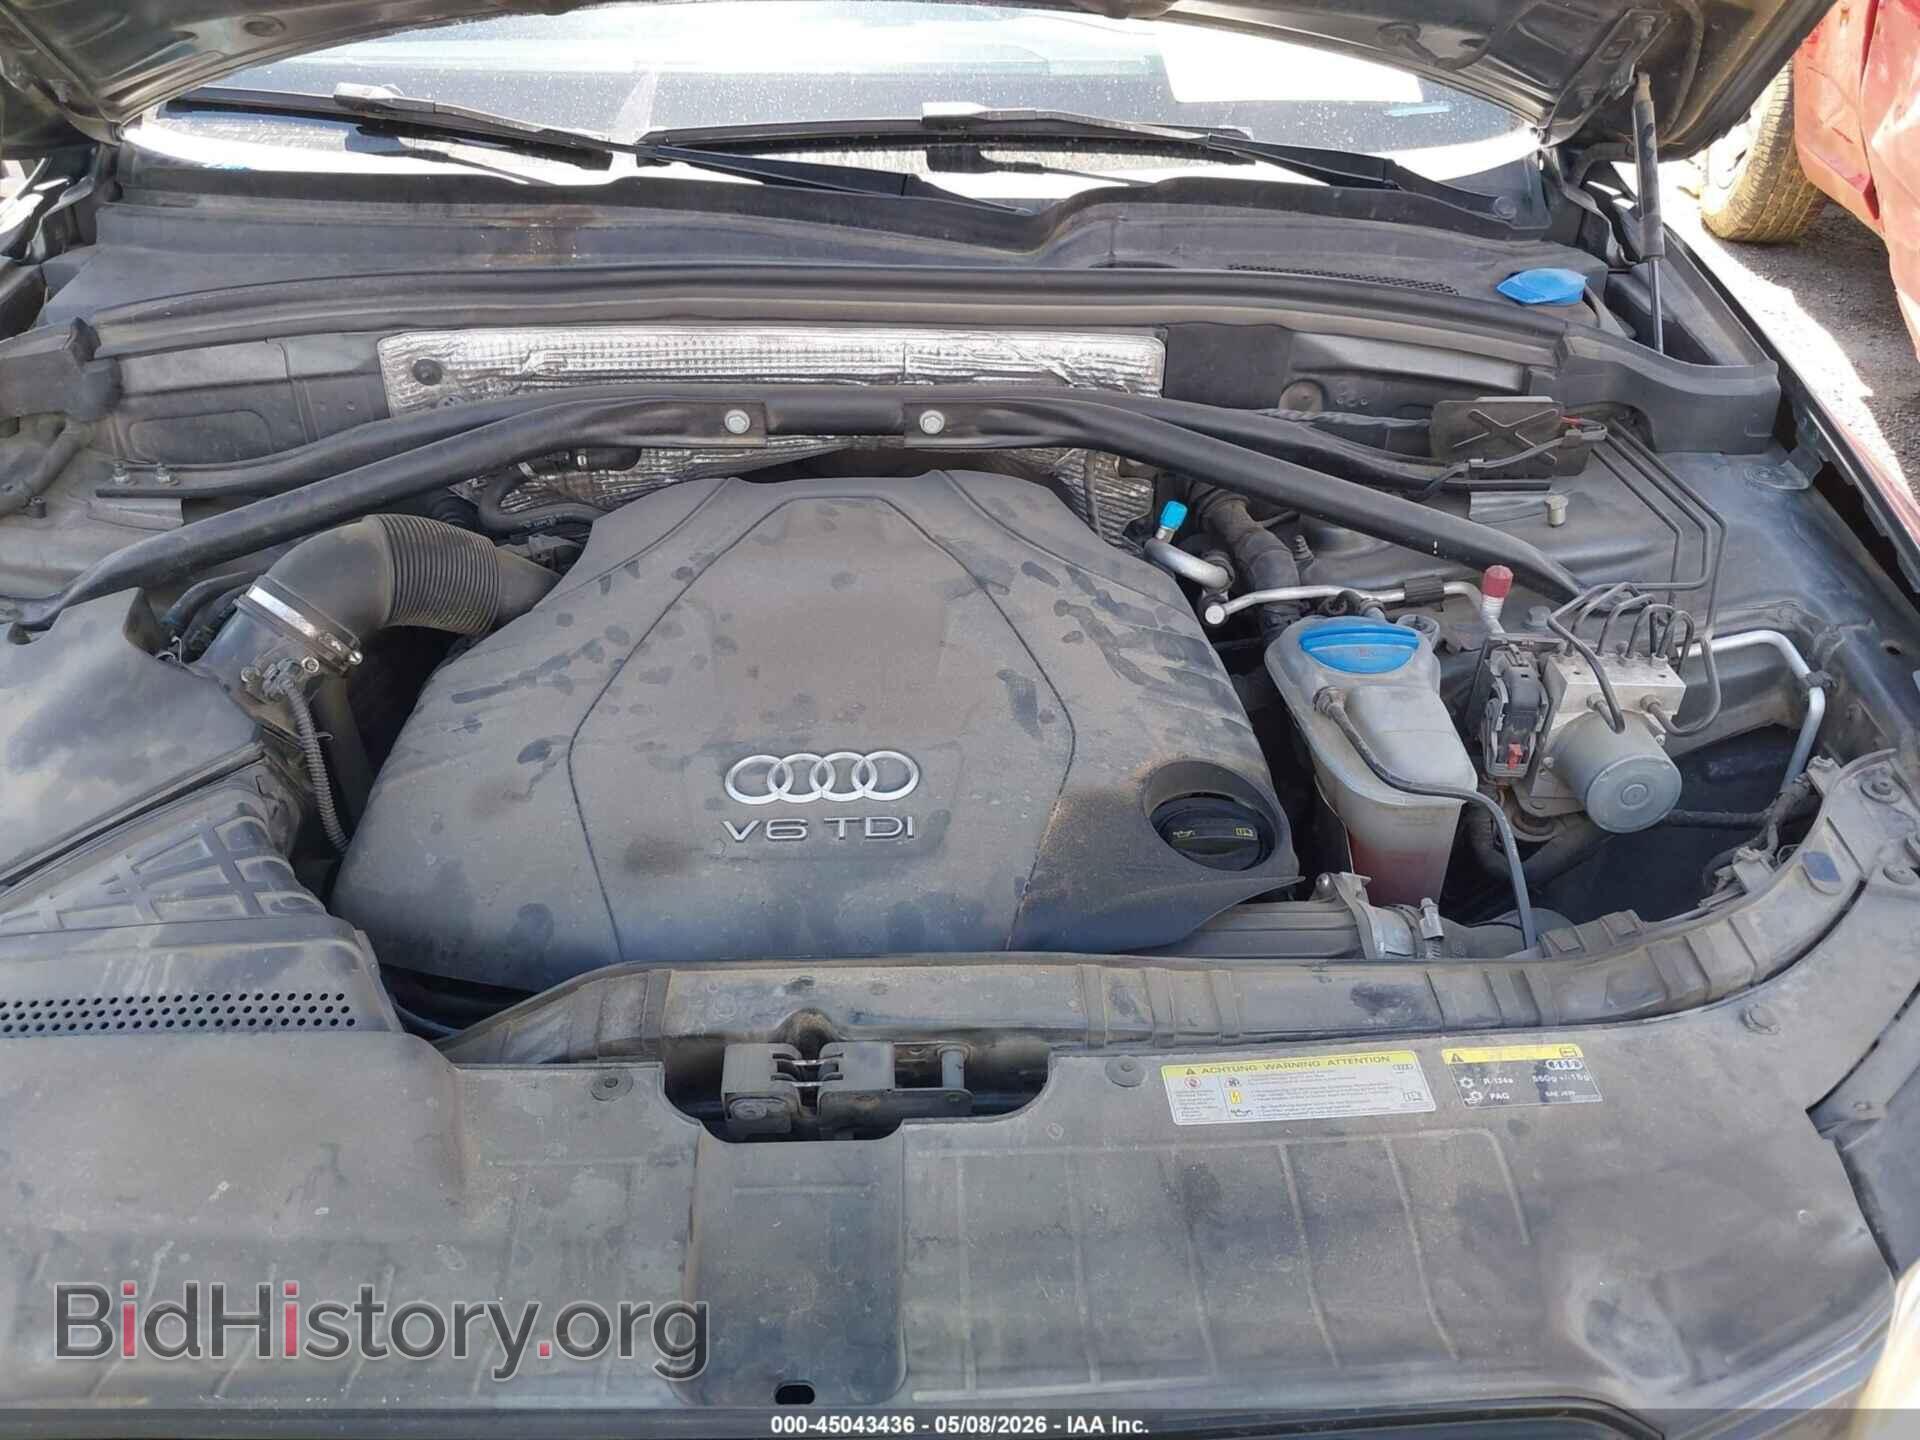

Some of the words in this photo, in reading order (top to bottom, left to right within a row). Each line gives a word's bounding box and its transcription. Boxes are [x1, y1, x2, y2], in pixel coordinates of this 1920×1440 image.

[722, 817, 809, 842] V6
[823, 815, 915, 840] TDI
[1201, 1064, 1258, 1075] ACHTUNG
[1263, 1060, 1321, 1070] WARNING
[1327, 1055, 1391, 1066] ATTENTION
